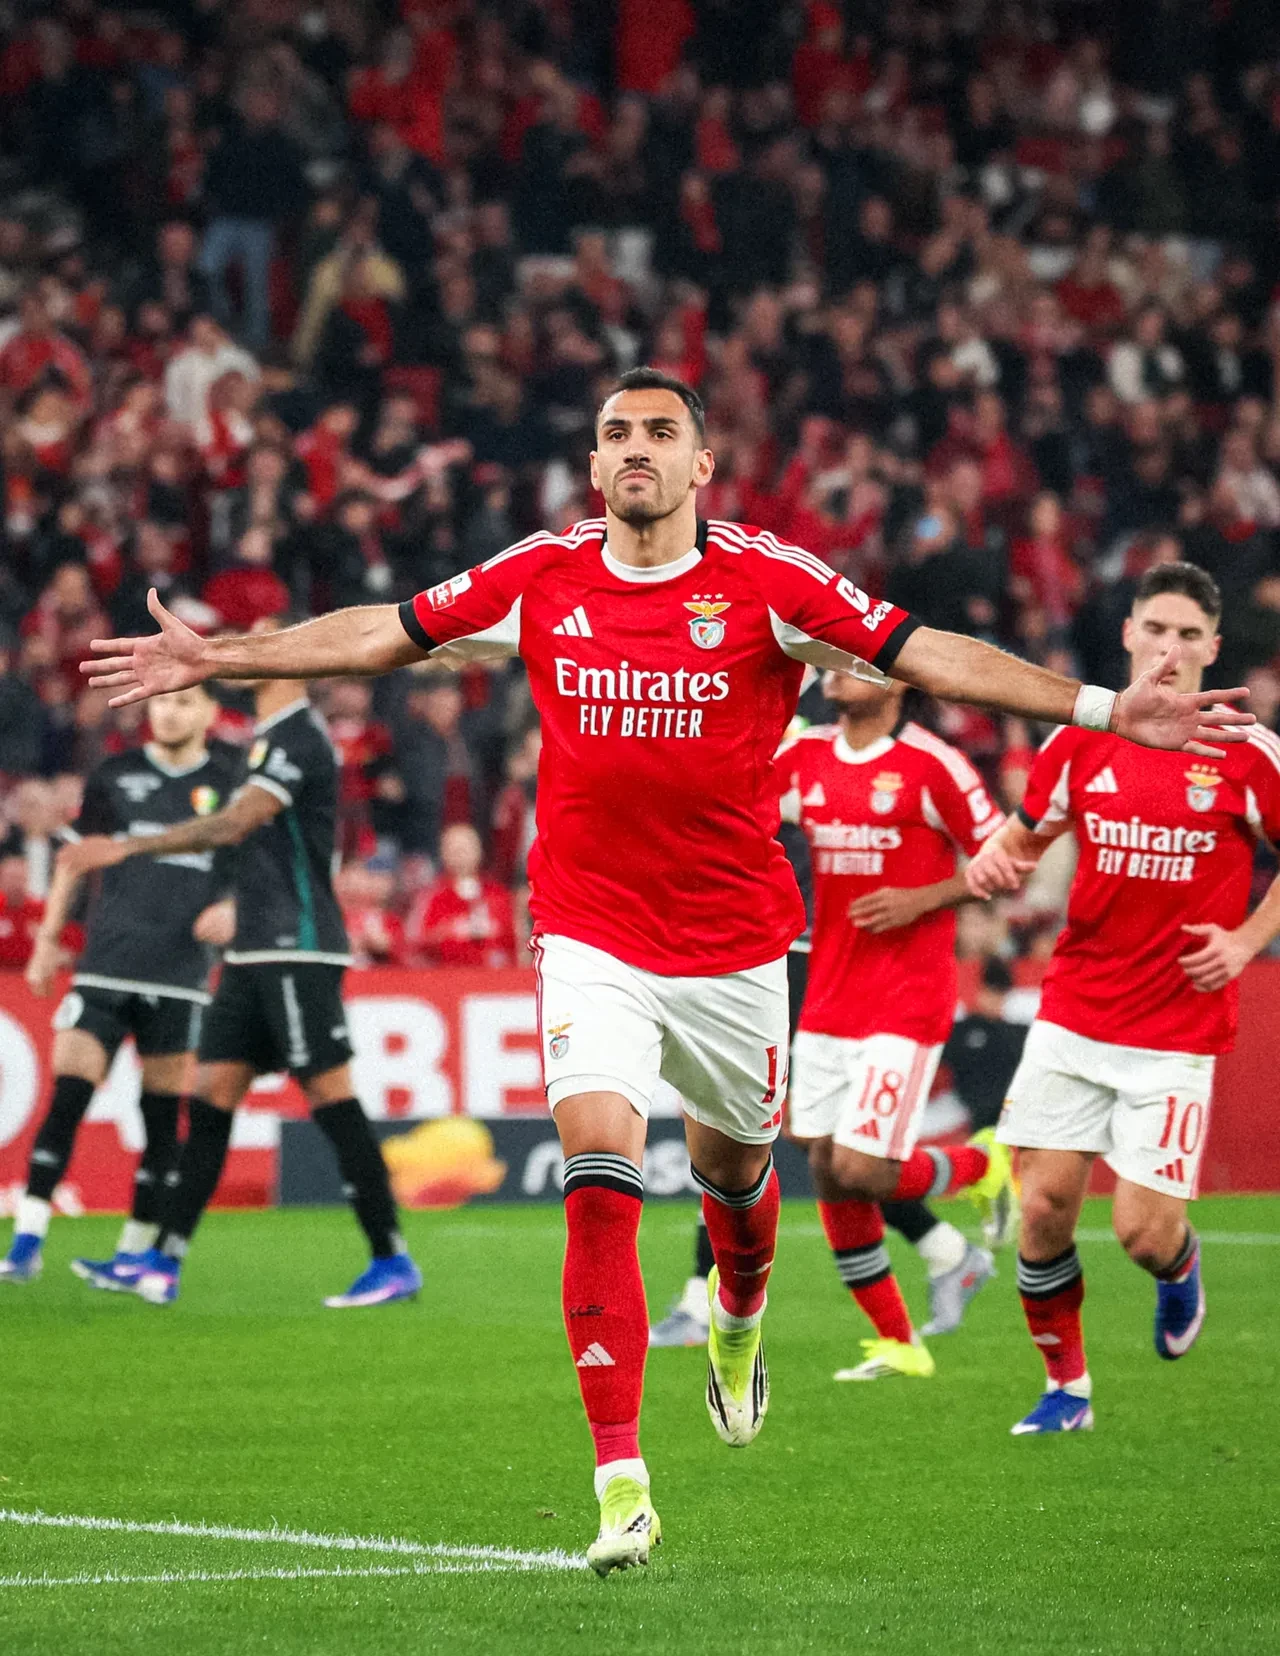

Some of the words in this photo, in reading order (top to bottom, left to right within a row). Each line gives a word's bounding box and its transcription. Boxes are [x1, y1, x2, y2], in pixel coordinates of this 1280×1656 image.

[554, 657, 730, 703] Emirates
[579, 704, 613, 736] FLY
[620, 706, 703, 738] BETTER
[1084, 811, 1217, 853] Emirates
[1096, 848, 1125, 875] FLY
[1127, 852, 1195, 881] BETTER
[857, 1065, 904, 1117] 18
[1159, 1095, 1203, 1155] 10
